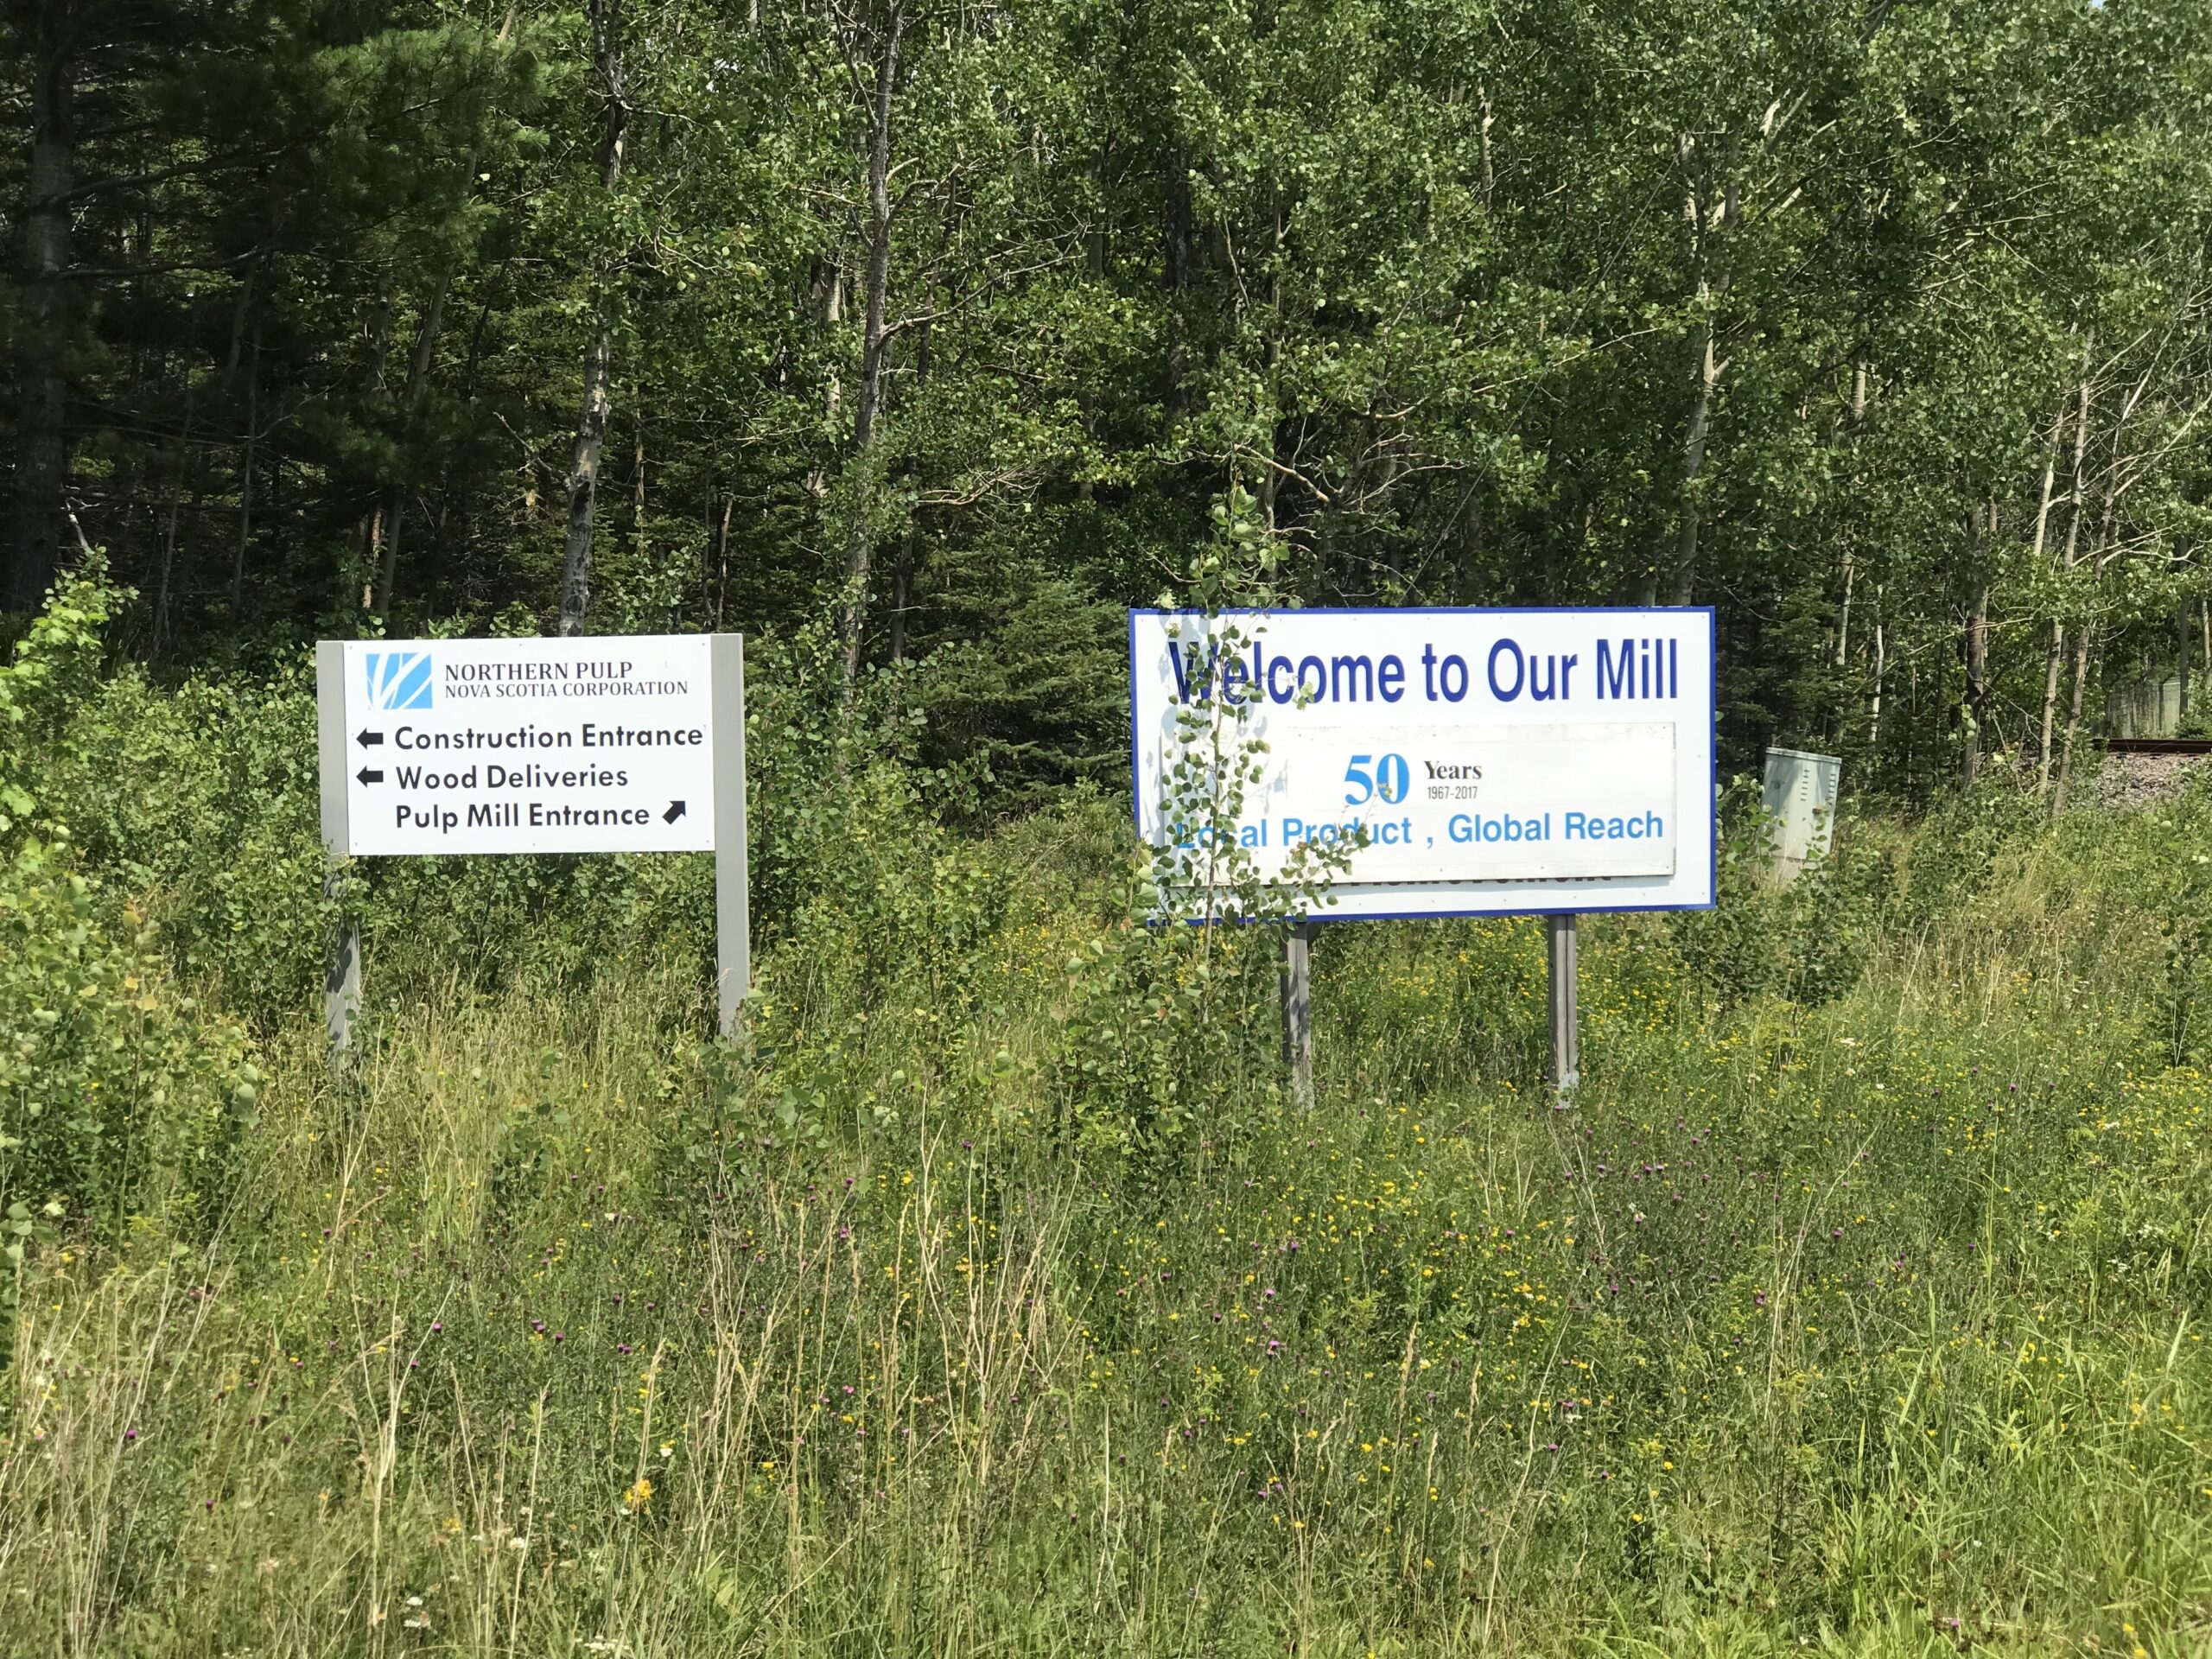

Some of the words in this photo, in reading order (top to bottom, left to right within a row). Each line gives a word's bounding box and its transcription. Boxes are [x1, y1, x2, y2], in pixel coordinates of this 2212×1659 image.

[445, 663, 569, 681] NORTHERN
[575, 661, 633, 679] PULP
[1168, 640, 1405, 704] Welcome
[1421, 643, 1469, 702] to
[1487, 638, 1578, 702] Our
[1596, 638, 1678, 700] Mill
[445, 684, 491, 698] NOVA
[495, 683, 557, 697] SCOTIA
[563, 680, 689, 696] CORPORATION
[395, 724, 572, 750] Construction
[582, 723, 703, 747] Entrance
[396, 766, 477, 790] Wood
[487, 763, 628, 788] Deliveries
[1344, 753, 1410, 805] 50
[1424, 760, 1482, 780] Years
[1427, 785, 1478, 799] 1967-2017
[396, 804, 459, 833] Pulp
[467, 803, 518, 827] Mill
[529, 801, 650, 826] Entrance
[1282, 817, 1412, 847] Product
[1448, 813, 1550, 843] Global
[1565, 810, 1663, 841] Reach
